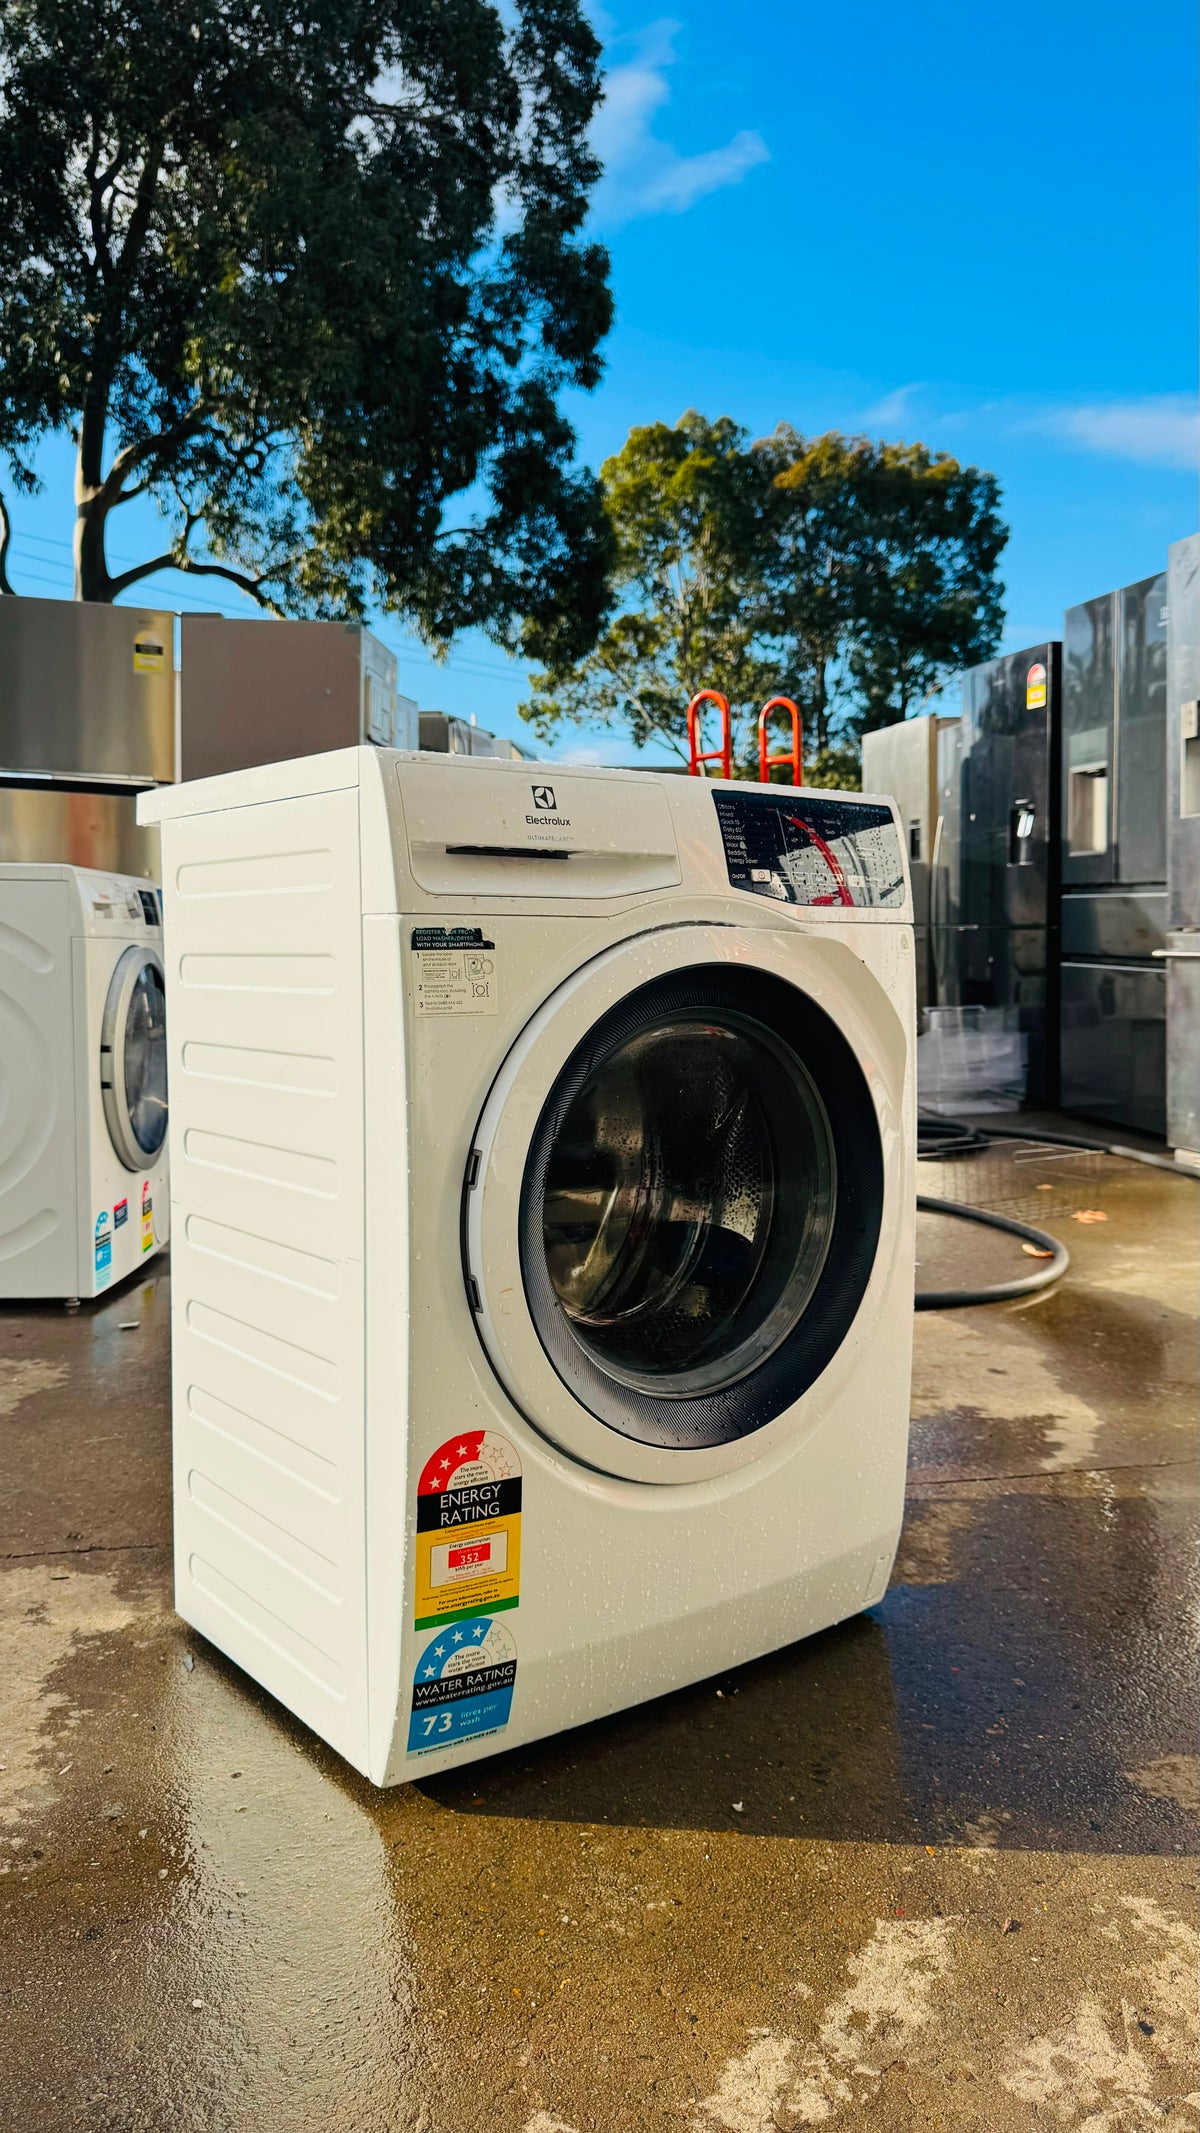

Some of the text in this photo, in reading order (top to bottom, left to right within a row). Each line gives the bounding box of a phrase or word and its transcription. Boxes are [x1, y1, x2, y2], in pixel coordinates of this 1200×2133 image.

[525, 815, 571, 826] Electrolux
[724, 833, 746, 841] Delicates
[727, 849, 747, 857] Bedding
[729, 857, 745, 865] Energy
[470, 1475, 489, 1483] efficient
[440, 1483, 502, 1509] ENERGY
[440, 1501, 501, 1527] RATING
[464, 1536, 491, 1546] consumption
[460, 1552, 480, 1565] 352
[471, 1655, 486, 1663] more
[464, 1661, 486, 1670] efficient
[416, 1664, 514, 1698] WATER RATING
[415, 1676, 513, 1707] www.waterrating.gov.au
[422, 1703, 498, 1737] 73 litres per
[459, 1716, 481, 1728] wash
